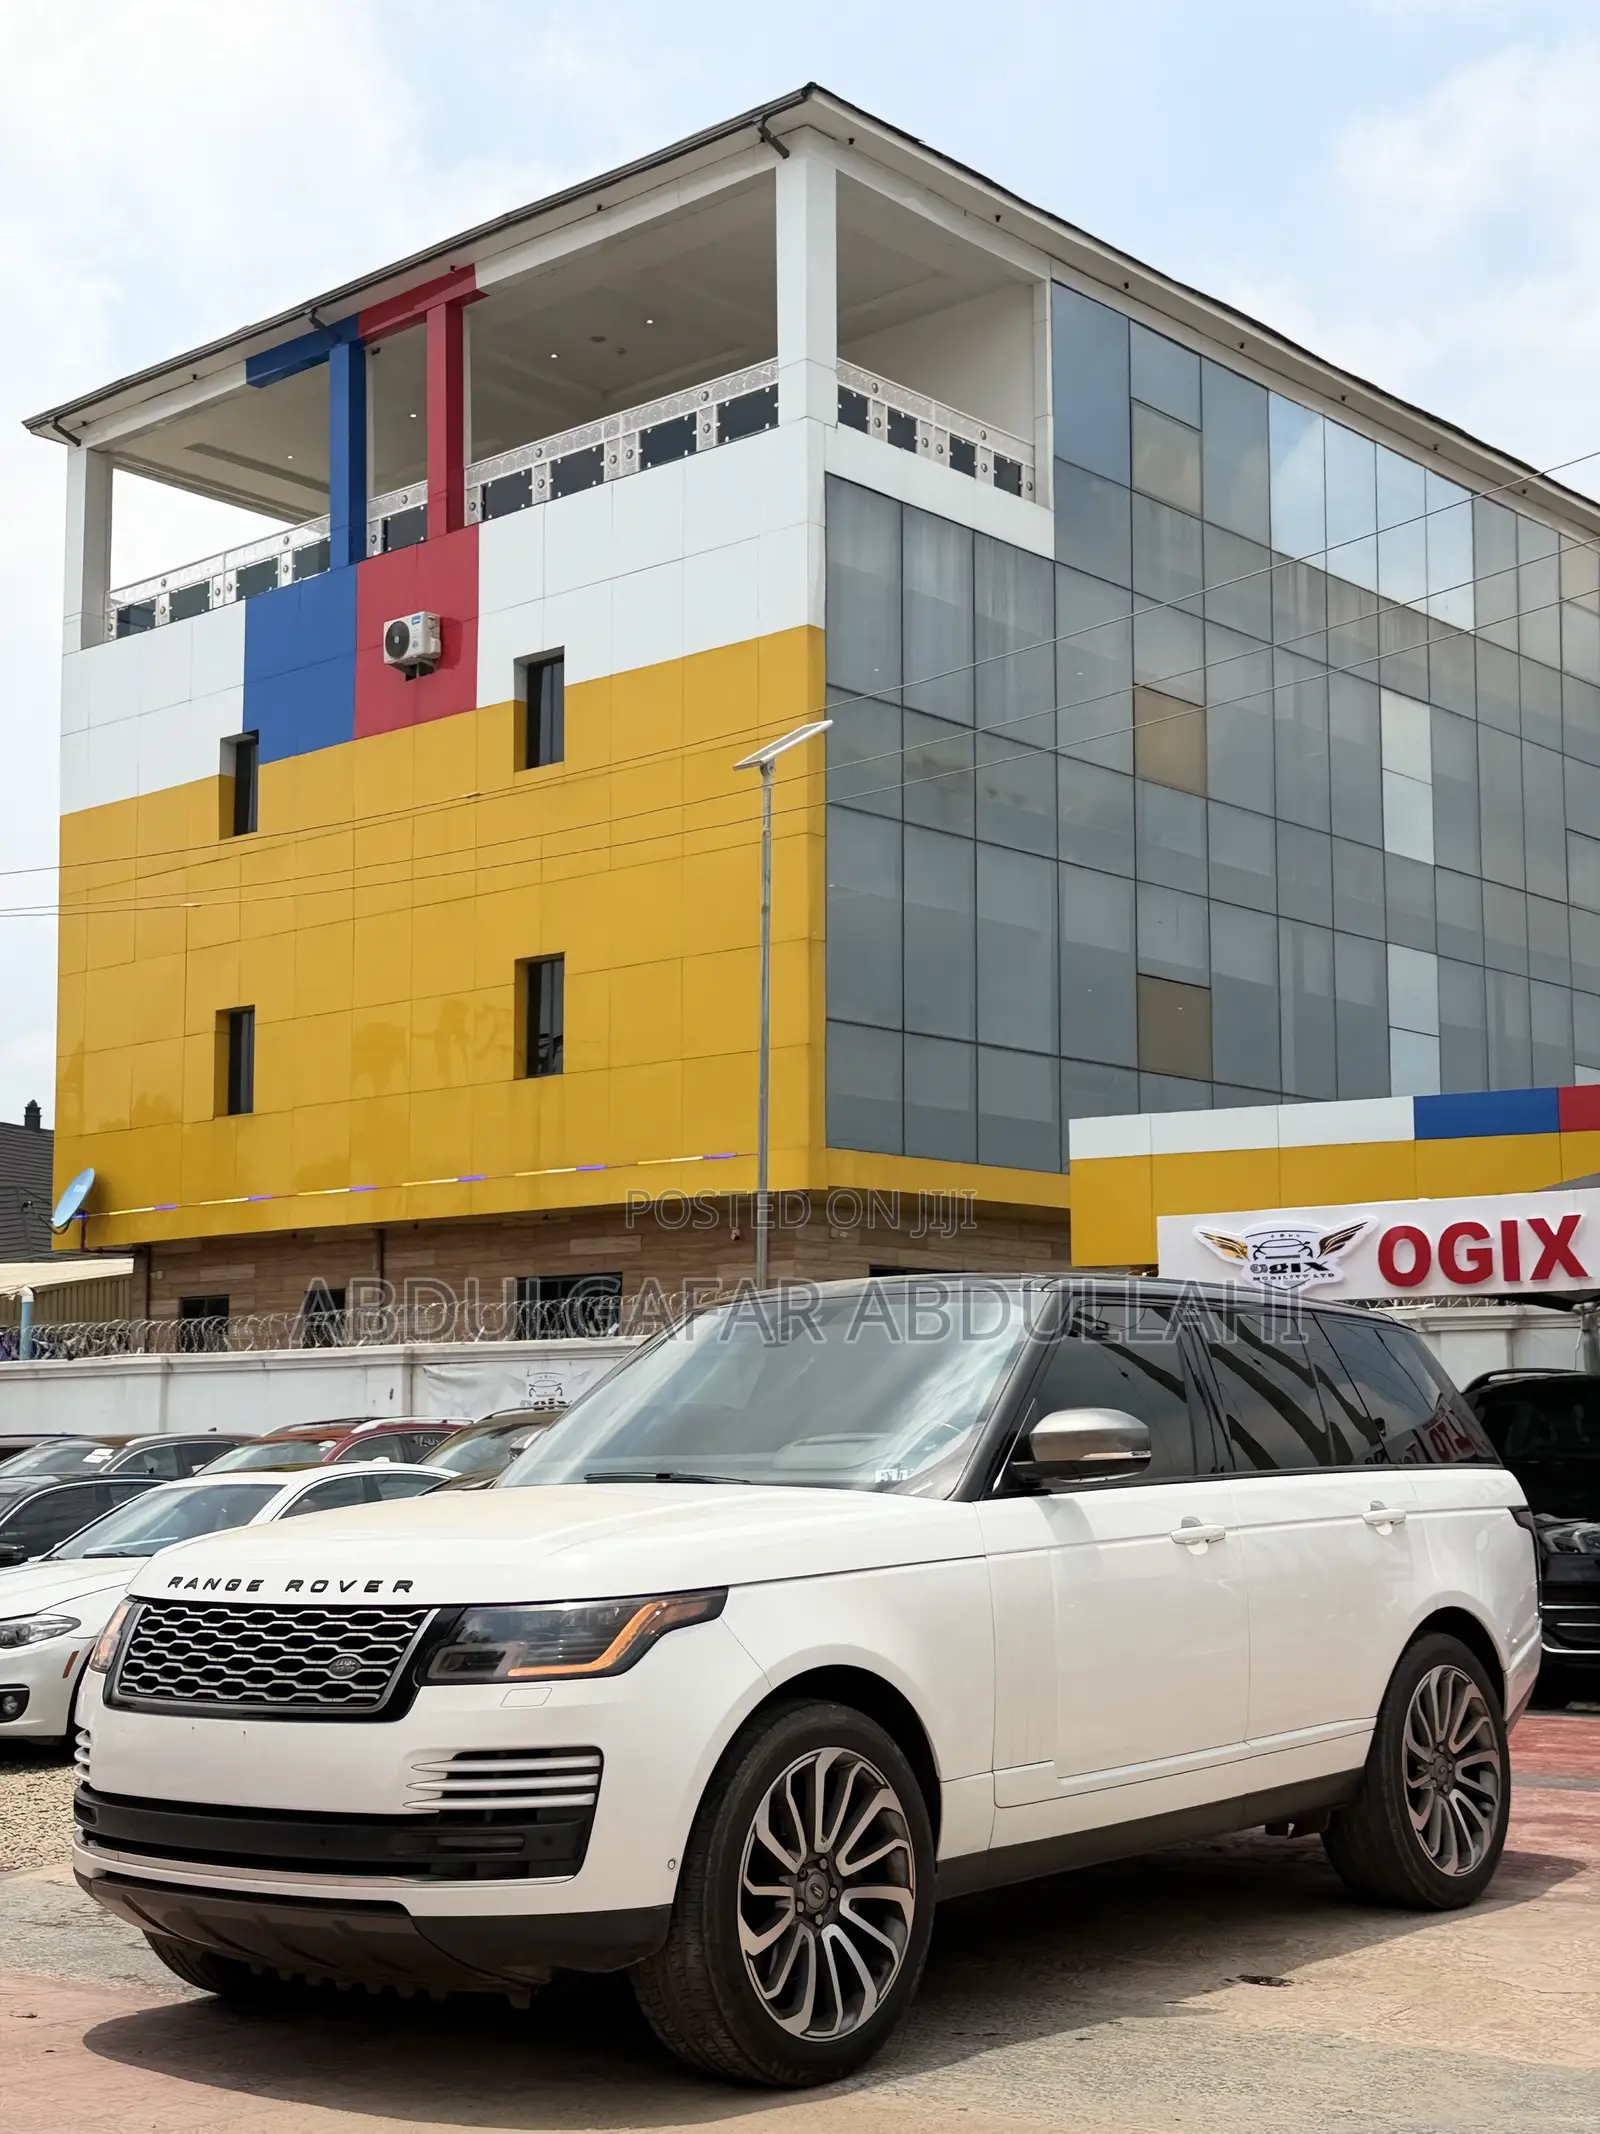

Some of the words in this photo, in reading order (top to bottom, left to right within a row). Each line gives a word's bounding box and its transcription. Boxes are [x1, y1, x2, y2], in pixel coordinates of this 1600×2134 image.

[1378, 1214, 1590, 1288] OGIX
[167, 1576, 265, 1593] RANGE
[285, 1579, 414, 1594] ROVER
